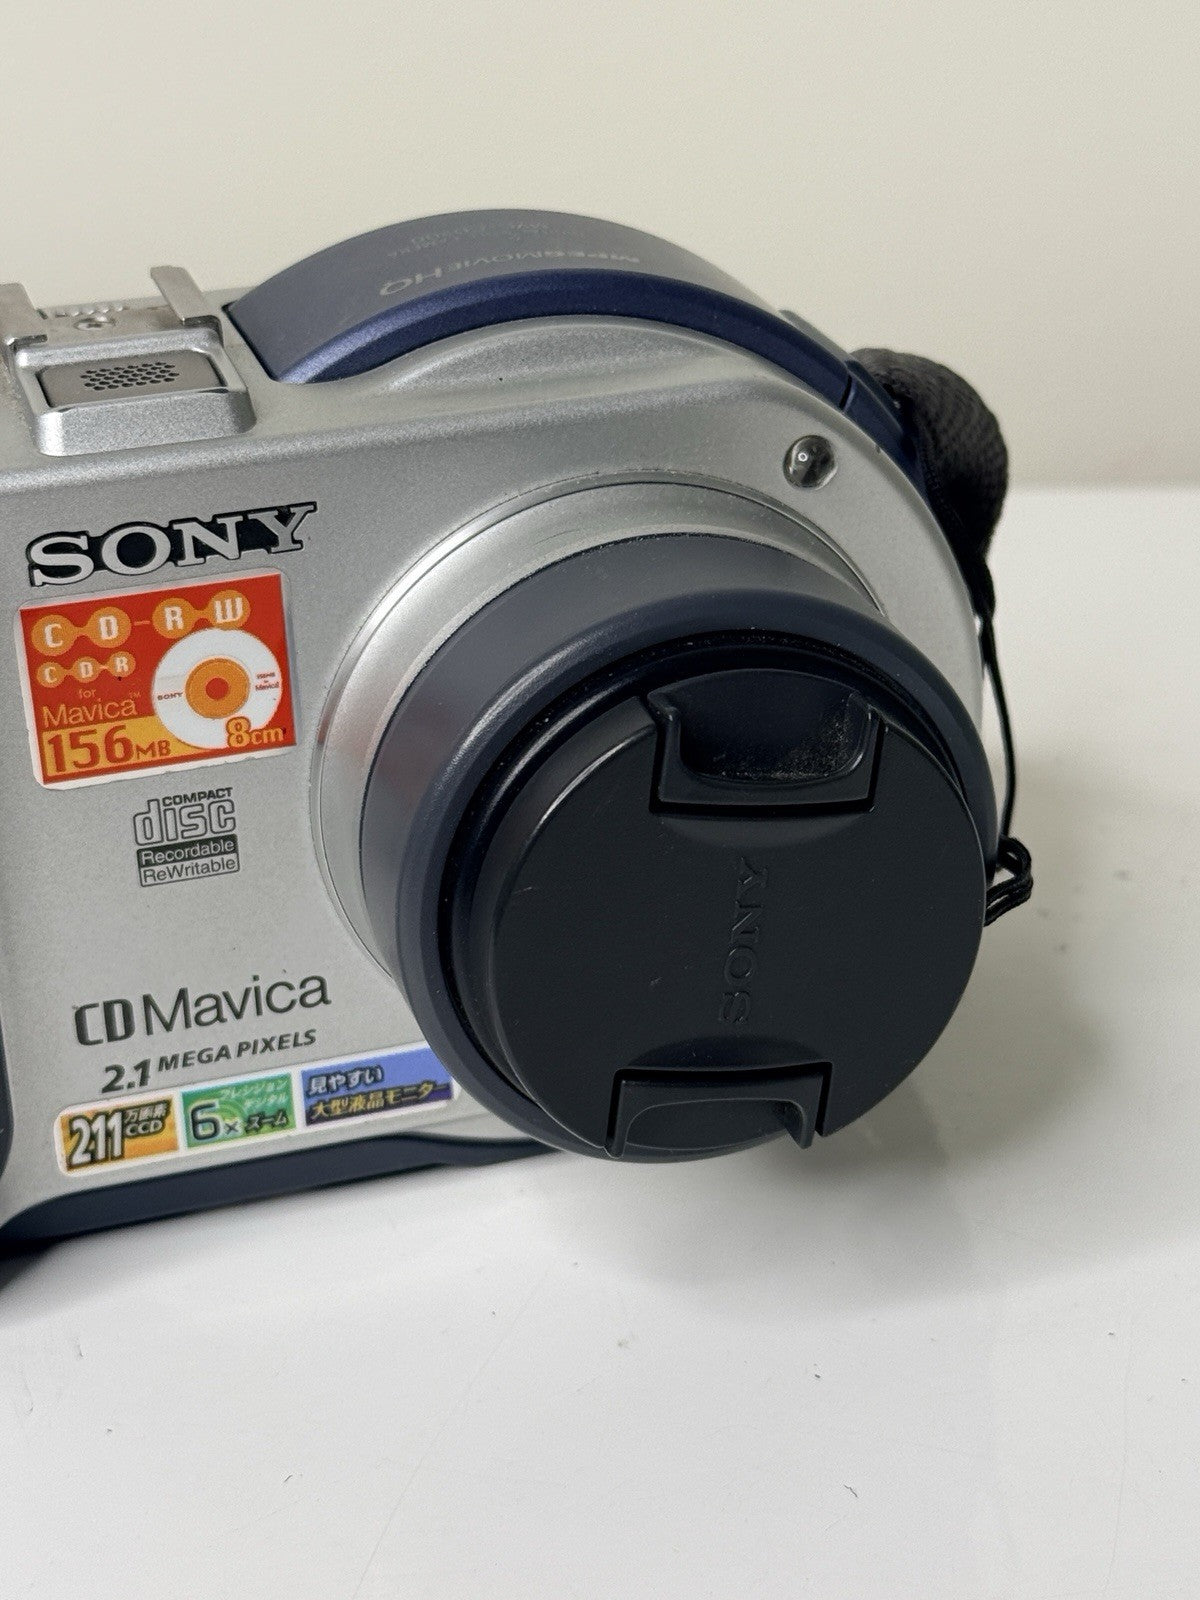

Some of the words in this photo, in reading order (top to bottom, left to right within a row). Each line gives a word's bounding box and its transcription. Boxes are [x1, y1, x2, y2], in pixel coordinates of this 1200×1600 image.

[26, 501, 318, 587] SONY
[78, 689, 97, 699] for
[157, 691, 184, 701] SONY
[226, 716, 285, 748] 8cm
[48, 724, 172, 773] 156MB
[161, 787, 233, 807] COMPACT
[133, 798, 237, 846] disc
[141, 839, 236, 867] Recordable
[143, 857, 237, 883] ReWritable
[717, 855, 769, 1025] SONY
[102, 1058, 151, 1093] 2.1
[158, 1043, 232, 1072] MEGA
[236, 1028, 318, 1058] PIXELS
[308, 1065, 384, 1096] 見やすい
[309, 1082, 448, 1121] 大型液晶モニター
[125, 1119, 164, 1136] CCD
